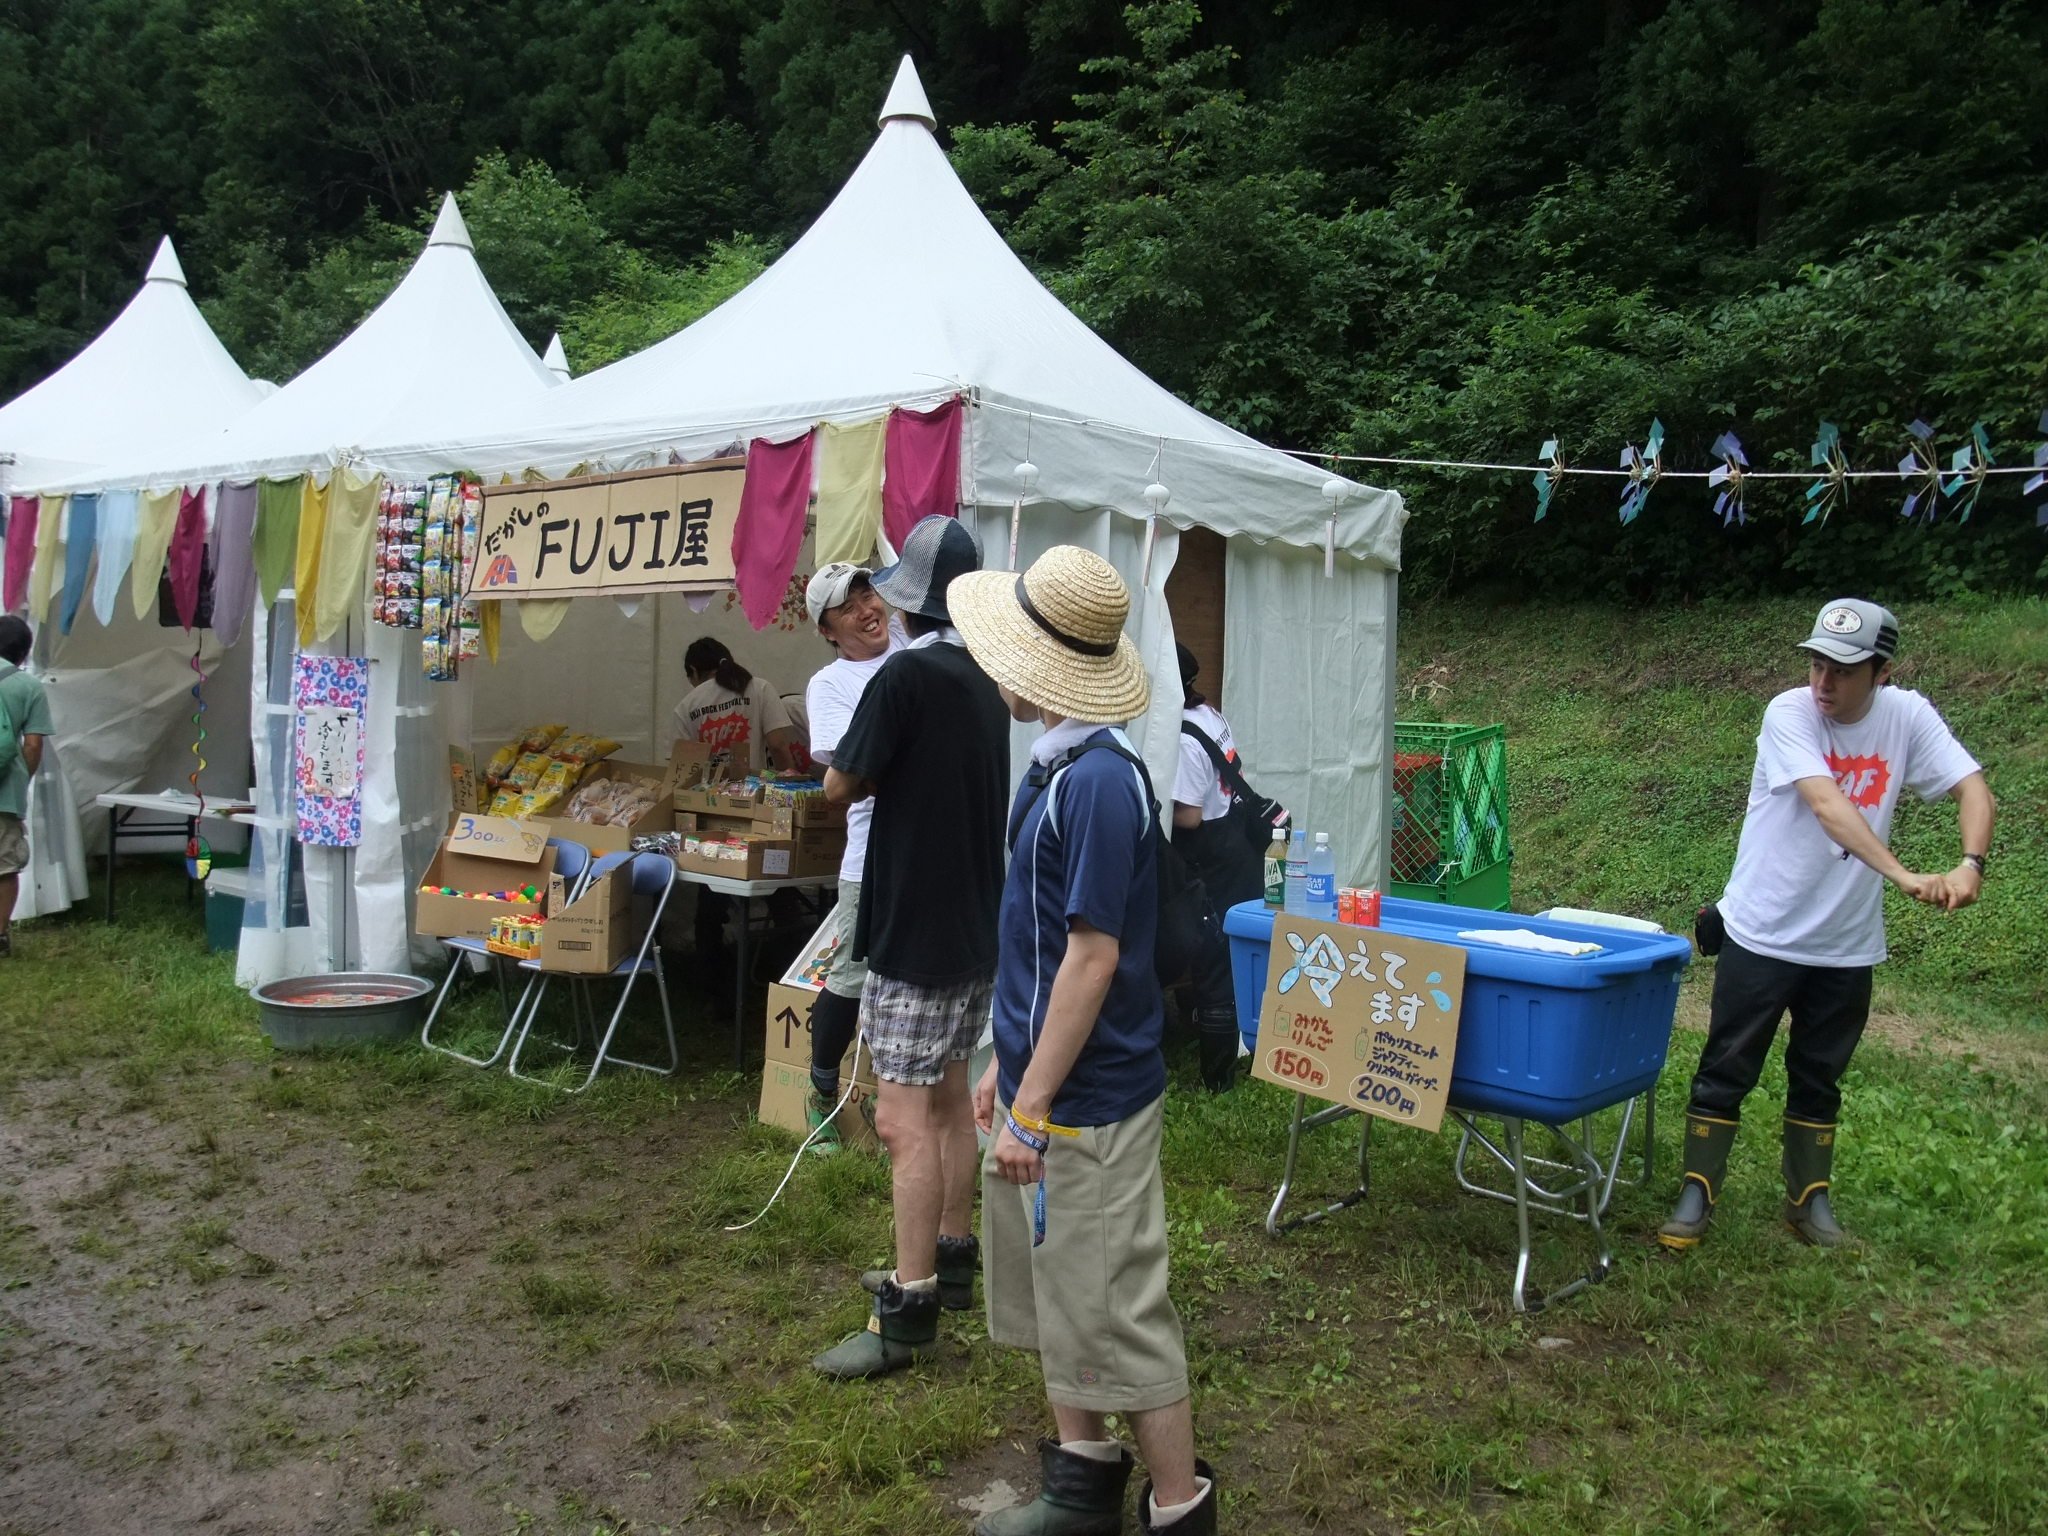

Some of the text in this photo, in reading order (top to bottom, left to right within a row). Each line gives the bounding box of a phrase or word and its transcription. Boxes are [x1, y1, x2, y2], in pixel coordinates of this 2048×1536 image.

[485, 500, 550, 557] だがしの
[535, 498, 714, 580] FUJI屋
[701, 704, 719, 716] ROCK
[718, 698, 742, 712] FESTIVAL
[702, 720, 745, 746] STAFF
[1277, 931, 1408, 1009] 冷えて
[1294, 1012, 1334, 1036] みかん
[1369, 989, 1426, 1033] ます
[1291, 1029, 1335, 1052] りんご
[1373, 1030, 1440, 1060] ポカリスエット
[1273, 1048, 1325, 1087] 150円
[1371, 1046, 1421, 1071] ジャワティー
[1365, 1059, 1440, 1092] クリスタルガイザー
[1356, 1076, 1416, 1116] 200円
